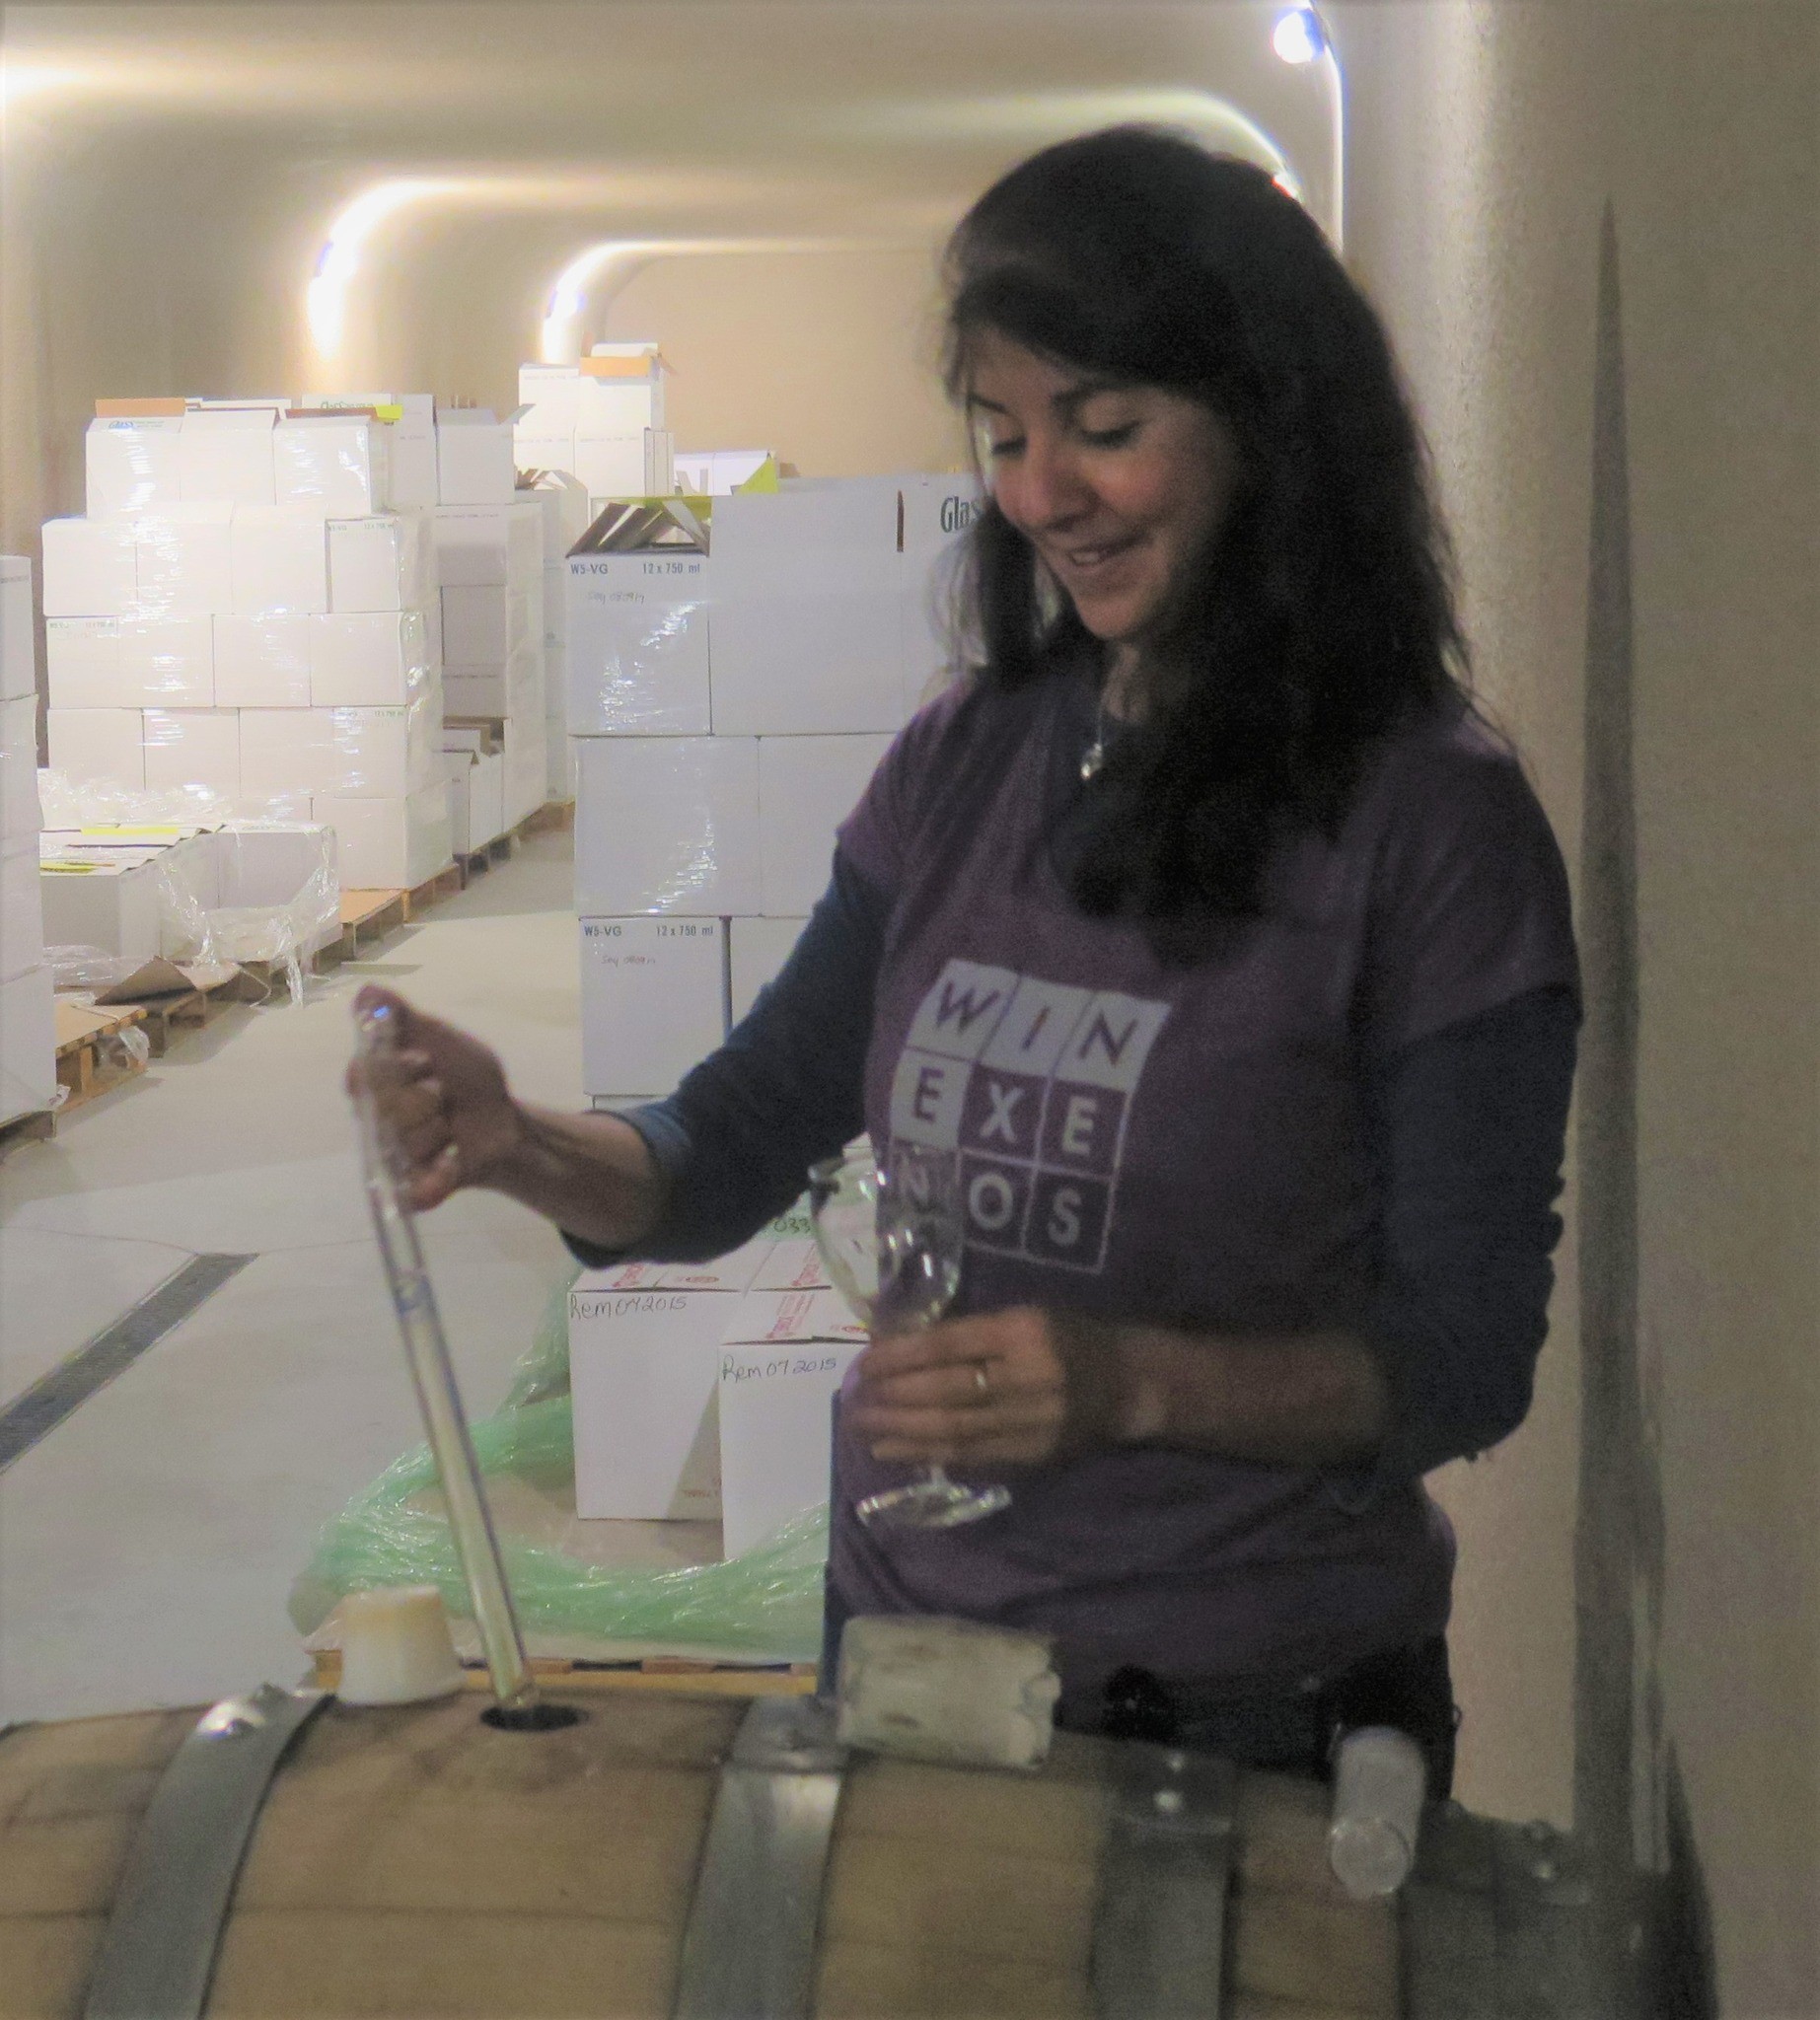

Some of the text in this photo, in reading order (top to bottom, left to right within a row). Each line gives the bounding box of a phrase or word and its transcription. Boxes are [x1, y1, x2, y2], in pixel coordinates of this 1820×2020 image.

[570, 562, 609, 575] W5-VG
[642, 562, 654, 575] 12
[665, 562, 684, 575] 750
[584, 925, 622, 937] W5-VG
[656, 925, 668, 937] 12
[679, 925, 696, 937] 750
[936, 980, 1138, 1068] WIN
[910, 1065, 1098, 1155] EXE
[898, 1156, 1083, 1248] NOS
